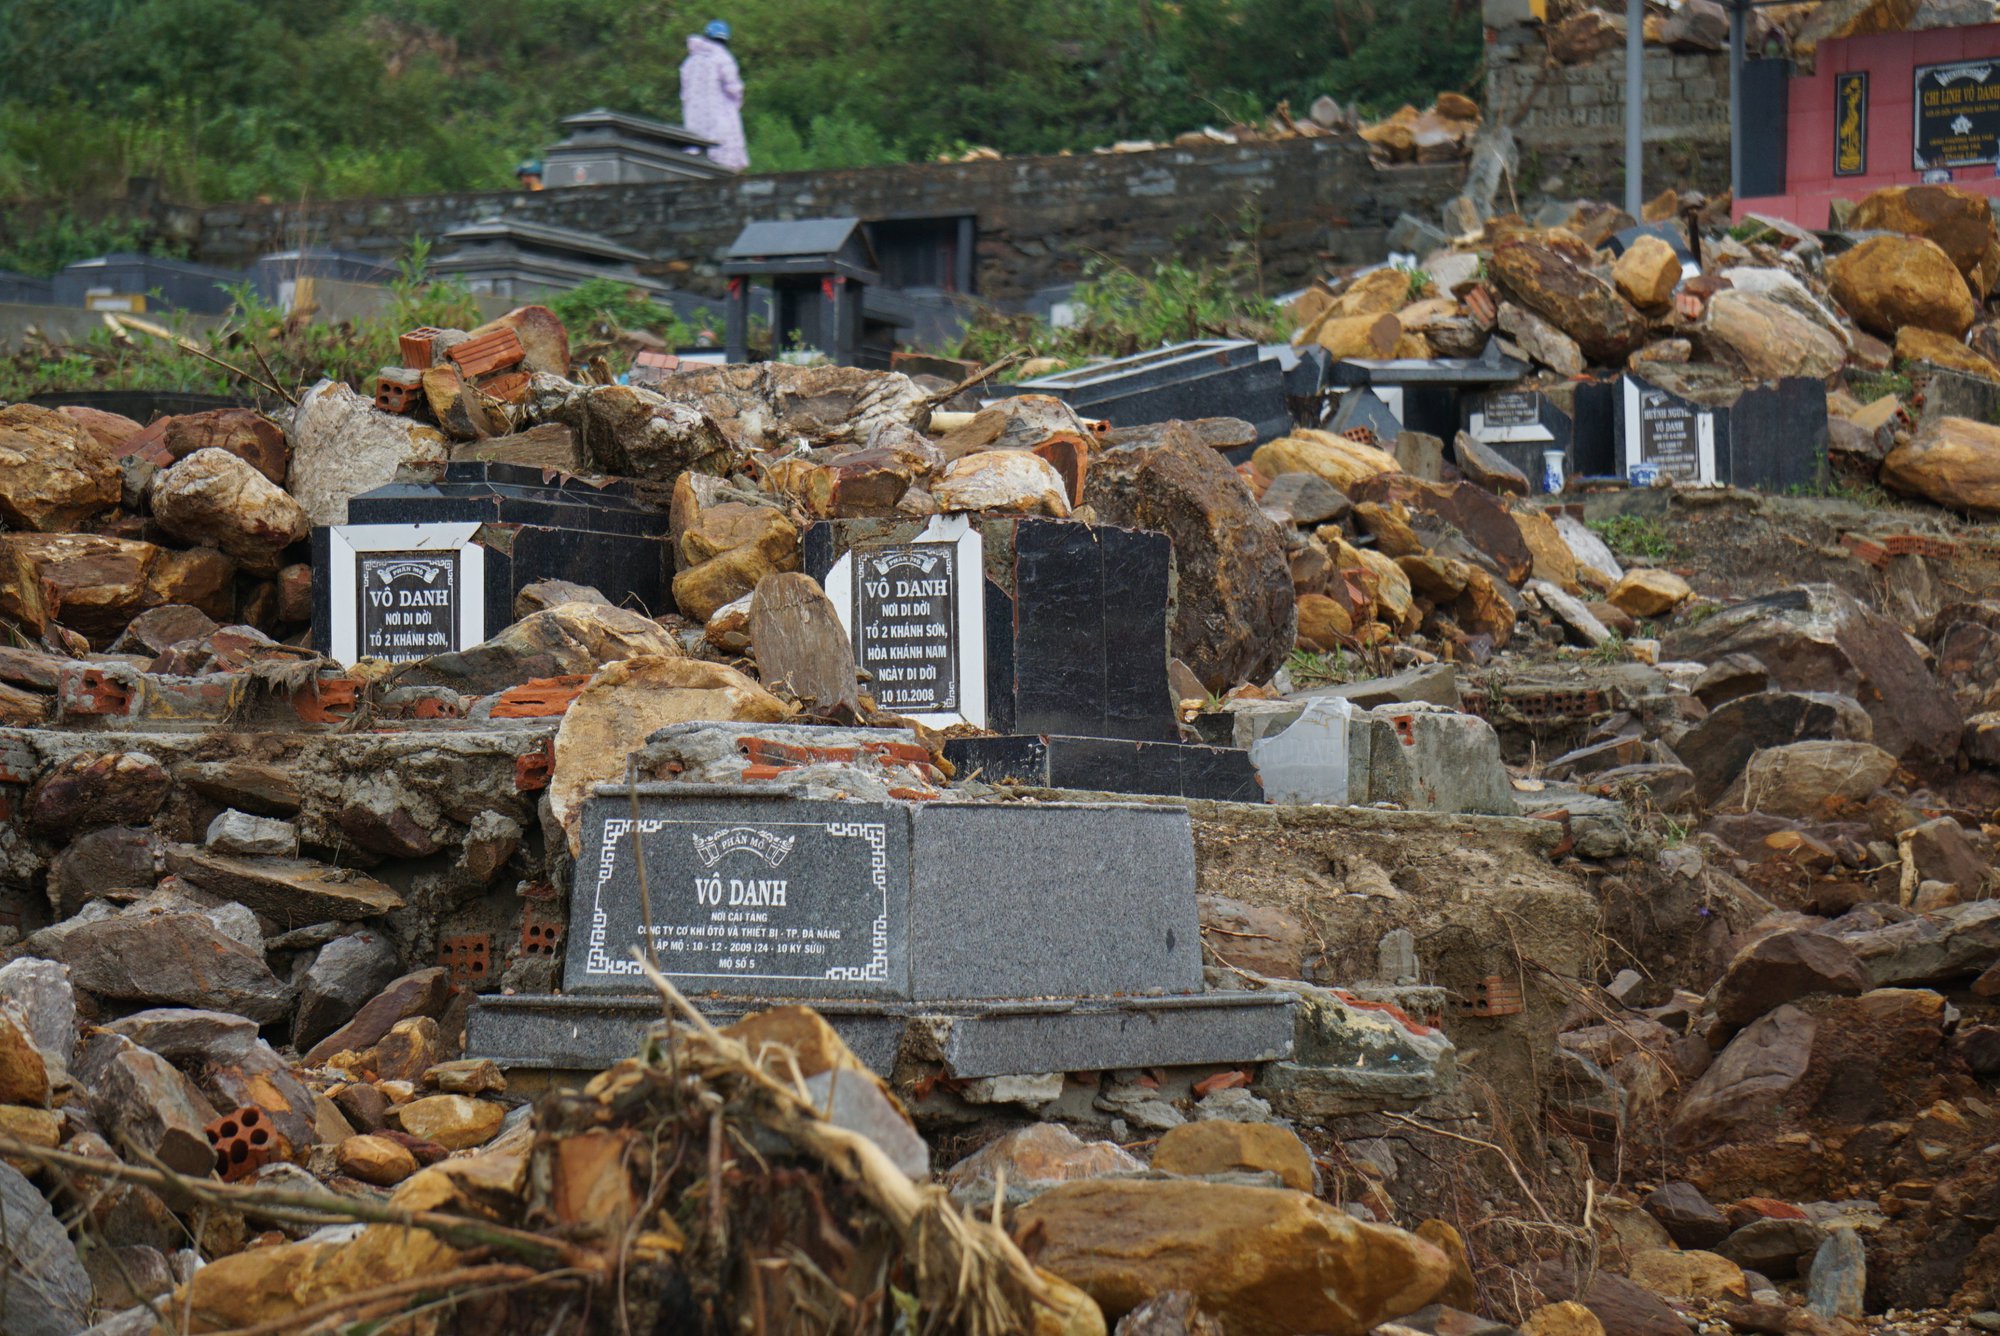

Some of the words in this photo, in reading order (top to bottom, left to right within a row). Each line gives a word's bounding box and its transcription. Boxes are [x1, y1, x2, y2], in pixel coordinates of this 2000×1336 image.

[1941, 87, 1962, 105] LINH
[369, 586, 394, 607] VÔ
[399, 590, 449, 606] DANH
[865, 577, 890, 598] VÔ
[896, 580, 948, 597] DANH
[882, 602, 898, 617] NƠI
[901, 603, 911, 617] DI
[914, 600, 930, 616] DỜI
[385, 611, 401, 626] NƠI
[403, 612, 413, 625] DI
[416, 610, 432, 625] DỜI
[369, 628, 382, 646] TỔ
[384, 633, 391, 646] 2
[393, 630, 425, 646] KHÁNH
[427, 632, 448, 647] SƠN,
[865, 620, 879, 639] TỔ
[881, 626, 889, 639] 2
[890, 622, 923, 639] KHÁNH
[926, 623, 948, 639] SƠN,
[867, 644, 887, 660] HÒA
[890, 643, 922, 660] KHÁNH
[926, 645, 947, 658] NAM
[879, 665, 904, 682] NGÀY
[907, 668, 917, 680] DI
[919, 664, 936, 680] DỜI
[721, 832, 748, 850] PHẦN
[695, 871, 722, 905] VÔ
[729, 879, 787, 906] DANH
[711, 909, 726, 922] NƠI
[663, 925, 674, 935] TY
[676, 925, 689, 936] CƠ
[690, 924, 705, 936] KHÍ
[707, 924, 725, 937] ÔTÔ
[727, 924, 739, 937] VÀ
[741, 924, 766, 937] THIẾT
[769, 927, 778, 940] BỊ
[786, 928, 800, 939] TP.
[802, 926, 814, 939] ĐÀ
[670, 938, 684, 952] MỘ
[693, 942, 703, 951] 10
[711, 942, 722, 952] 12
[730, 942, 752, 952] 2009
[754, 943, 768, 953] (24
[777, 943, 788, 953] 10
[719, 956, 732, 970] MỘ
[734, 955, 747, 969] SỐ
[749, 959, 755, 969] 5
